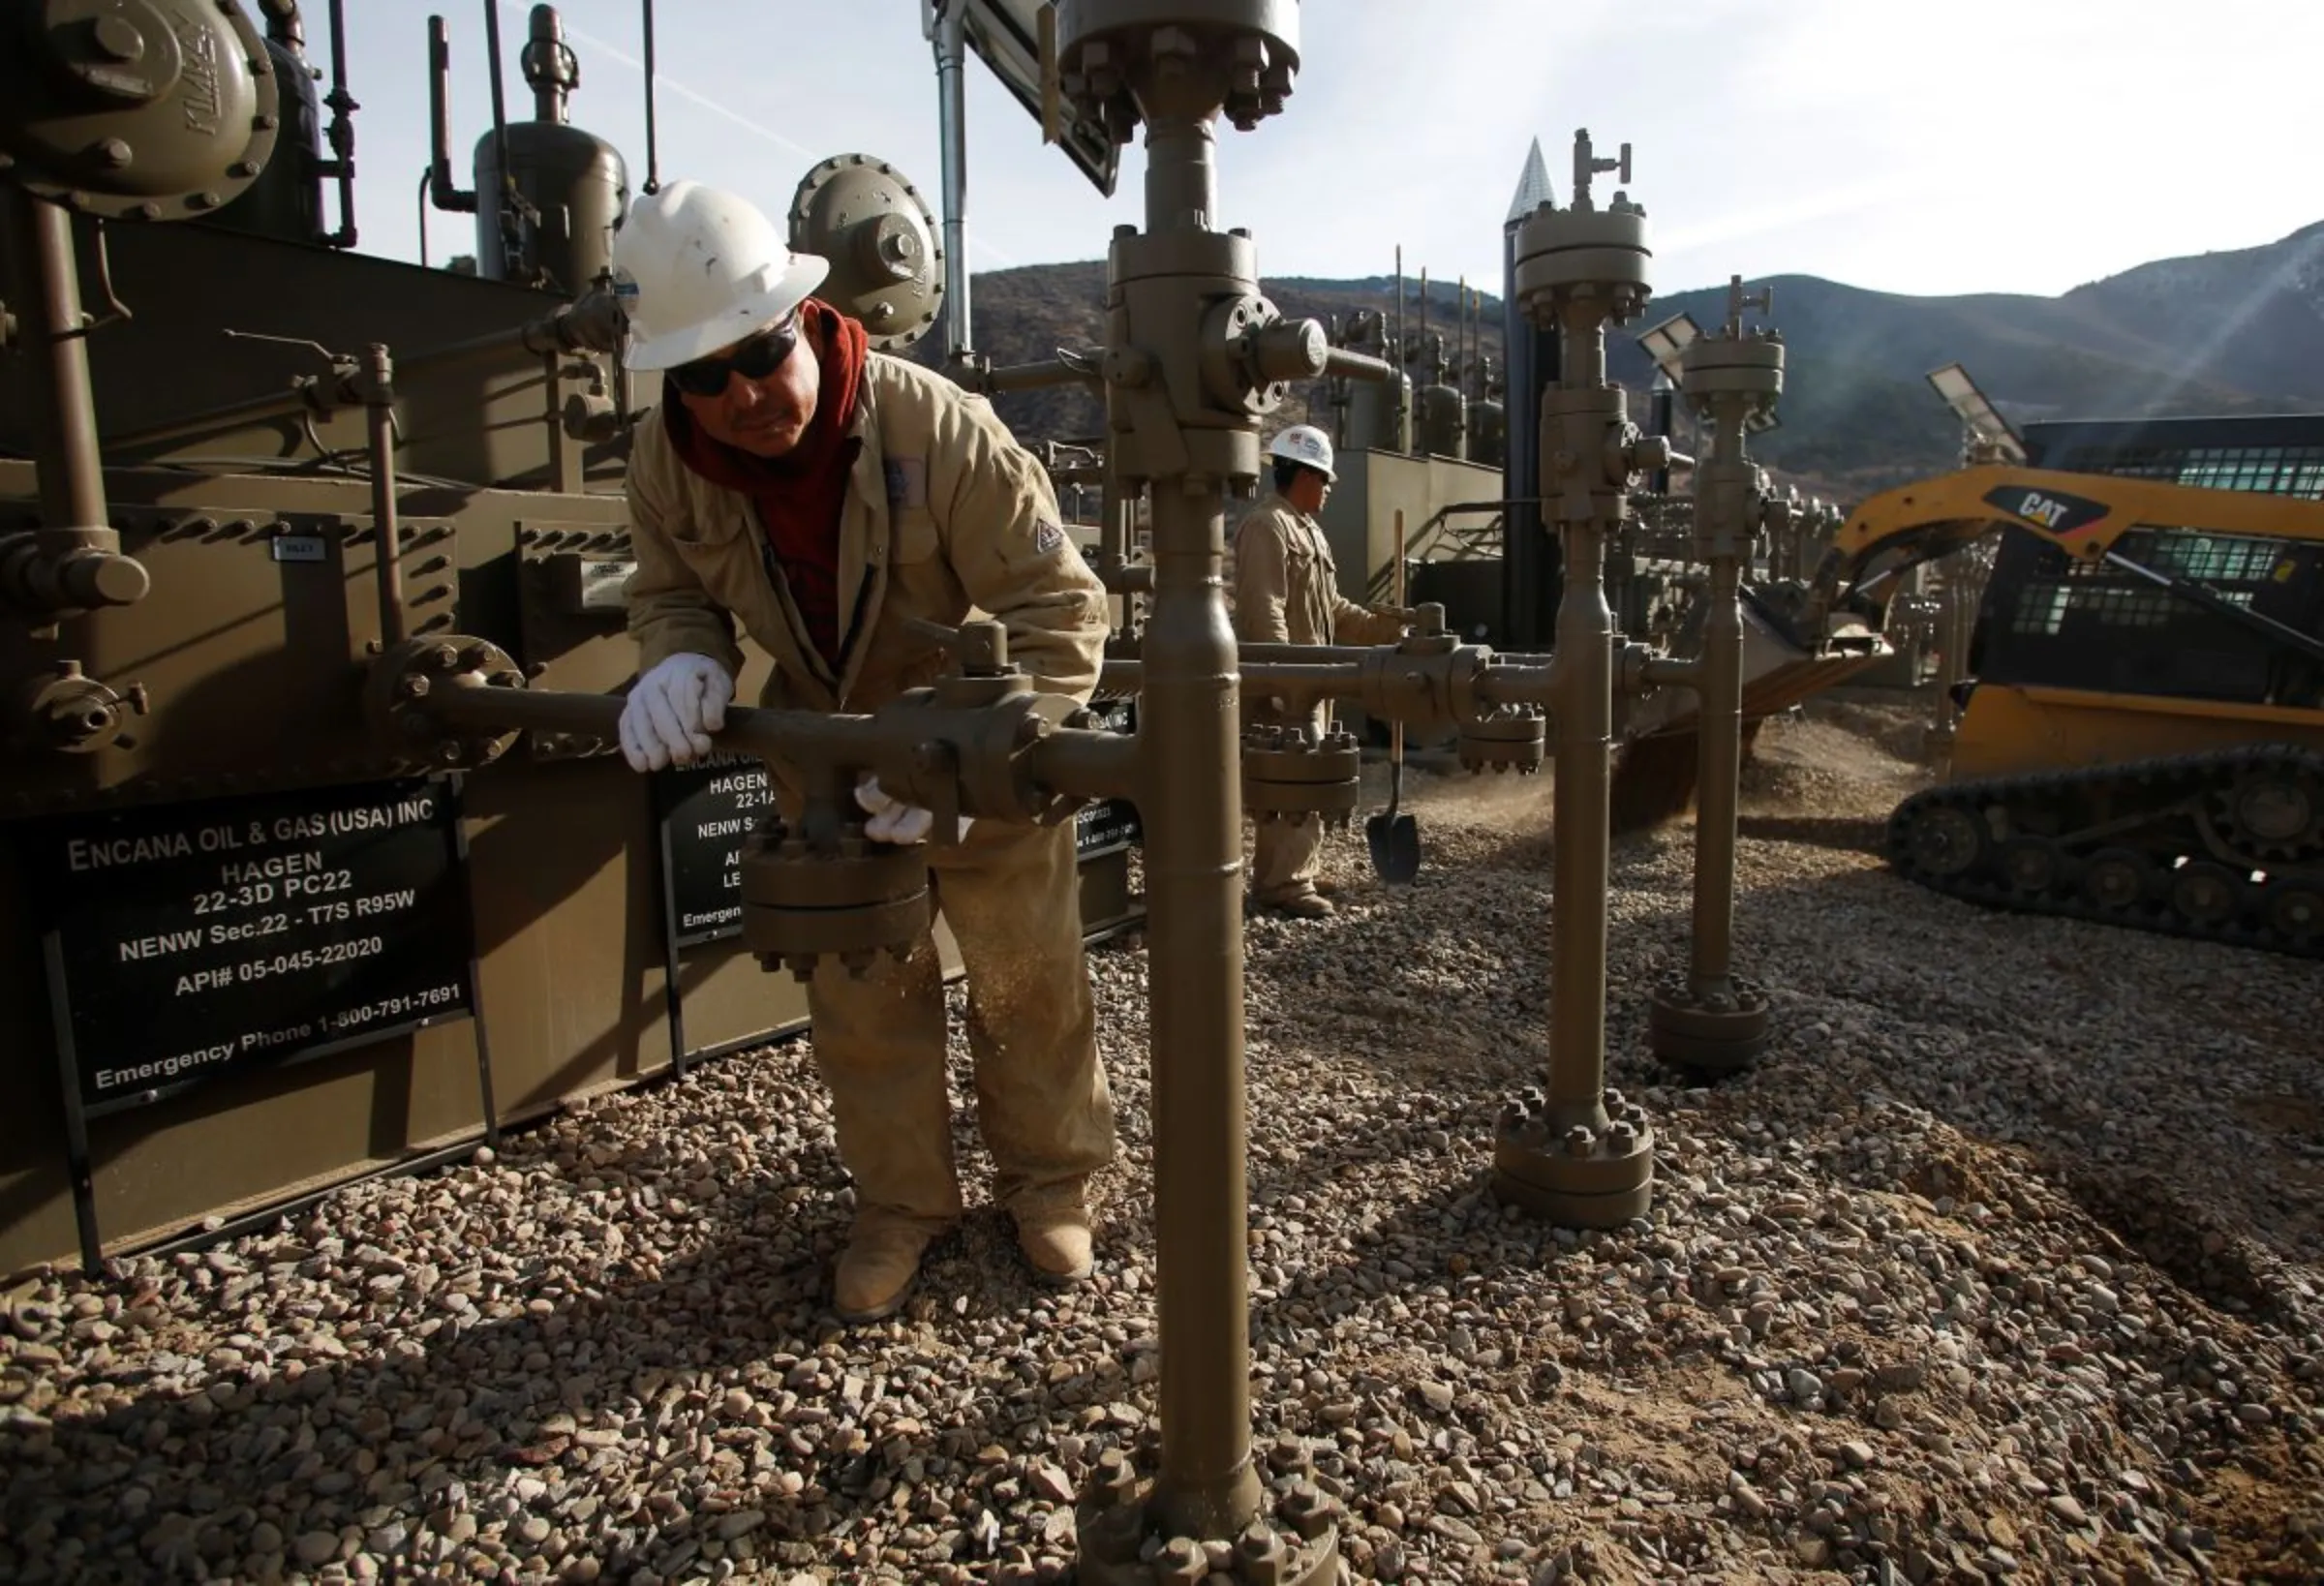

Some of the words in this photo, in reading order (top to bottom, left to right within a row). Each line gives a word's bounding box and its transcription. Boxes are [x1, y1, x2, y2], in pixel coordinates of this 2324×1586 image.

[2019, 492, 2068, 527] CAT
[710, 772, 768, 795] HAGEN
[68, 832, 193, 871] ENCANA
[199, 825, 243, 851] OIL
[248, 821, 267, 844] &
[274, 812, 326, 840] GAS
[330, 803, 393, 836] (USA)
[397, 798, 434, 824] INC
[697, 817, 741, 840] NENW
[221, 851, 323, 886] HAGEN
[194, 882, 274, 915] 22-3D
[284, 869, 352, 899] PC22
[119, 929, 202, 962] NENW
[209, 913, 289, 944] Sec.22
[307, 901, 350, 925] T7S
[355, 889, 415, 917] R95W
[174, 965, 233, 996] API#
[239, 935, 382, 982] 05-045-22020
[95, 1041, 235, 1089] Emergency
[241, 1023, 311, 1051] Phone
[317, 983, 461, 1033] 1-800-791-7691
